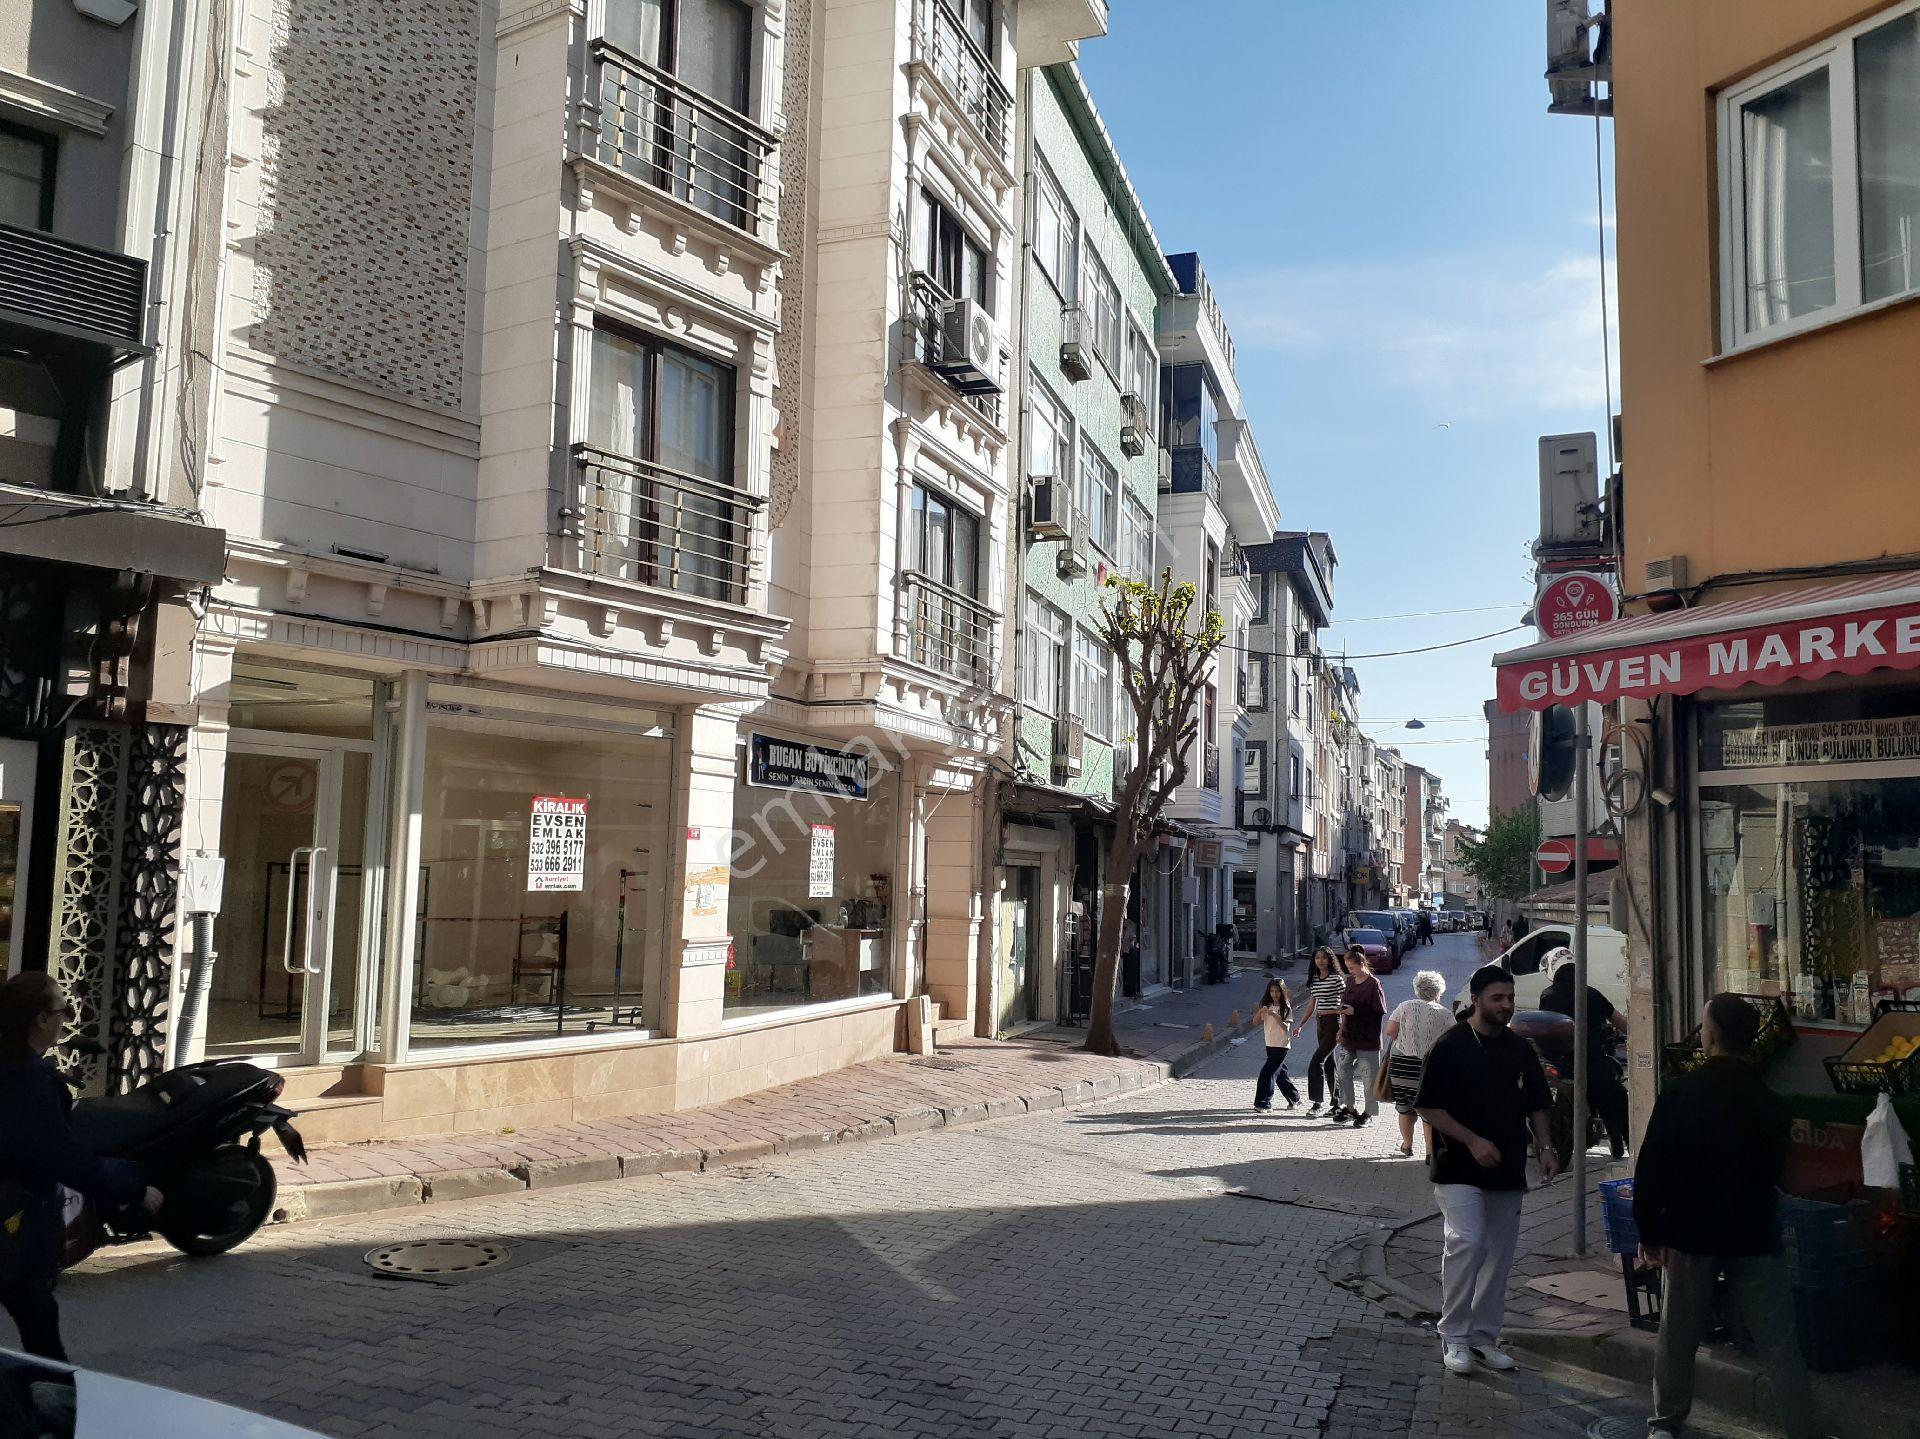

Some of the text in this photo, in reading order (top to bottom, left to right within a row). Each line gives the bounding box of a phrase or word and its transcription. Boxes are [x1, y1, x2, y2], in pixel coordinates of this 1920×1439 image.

[1553, 607, 1599, 621] 365 GÜN
[1553, 619, 1599, 629] DONDURMA
[1519, 615, 1920, 700] GÜVEN MARKE
[1821, 725, 1839, 740] SAÇ
[1822, 739, 1872, 760] BULUNUR
[533, 799, 585, 815] KİRALIK
[533, 814, 584, 827] EVSEN
[533, 828, 583, 838] EMLAK
[531, 840, 583, 855] 532 396 5177
[530, 856, 582, 871] 533 666 2911
